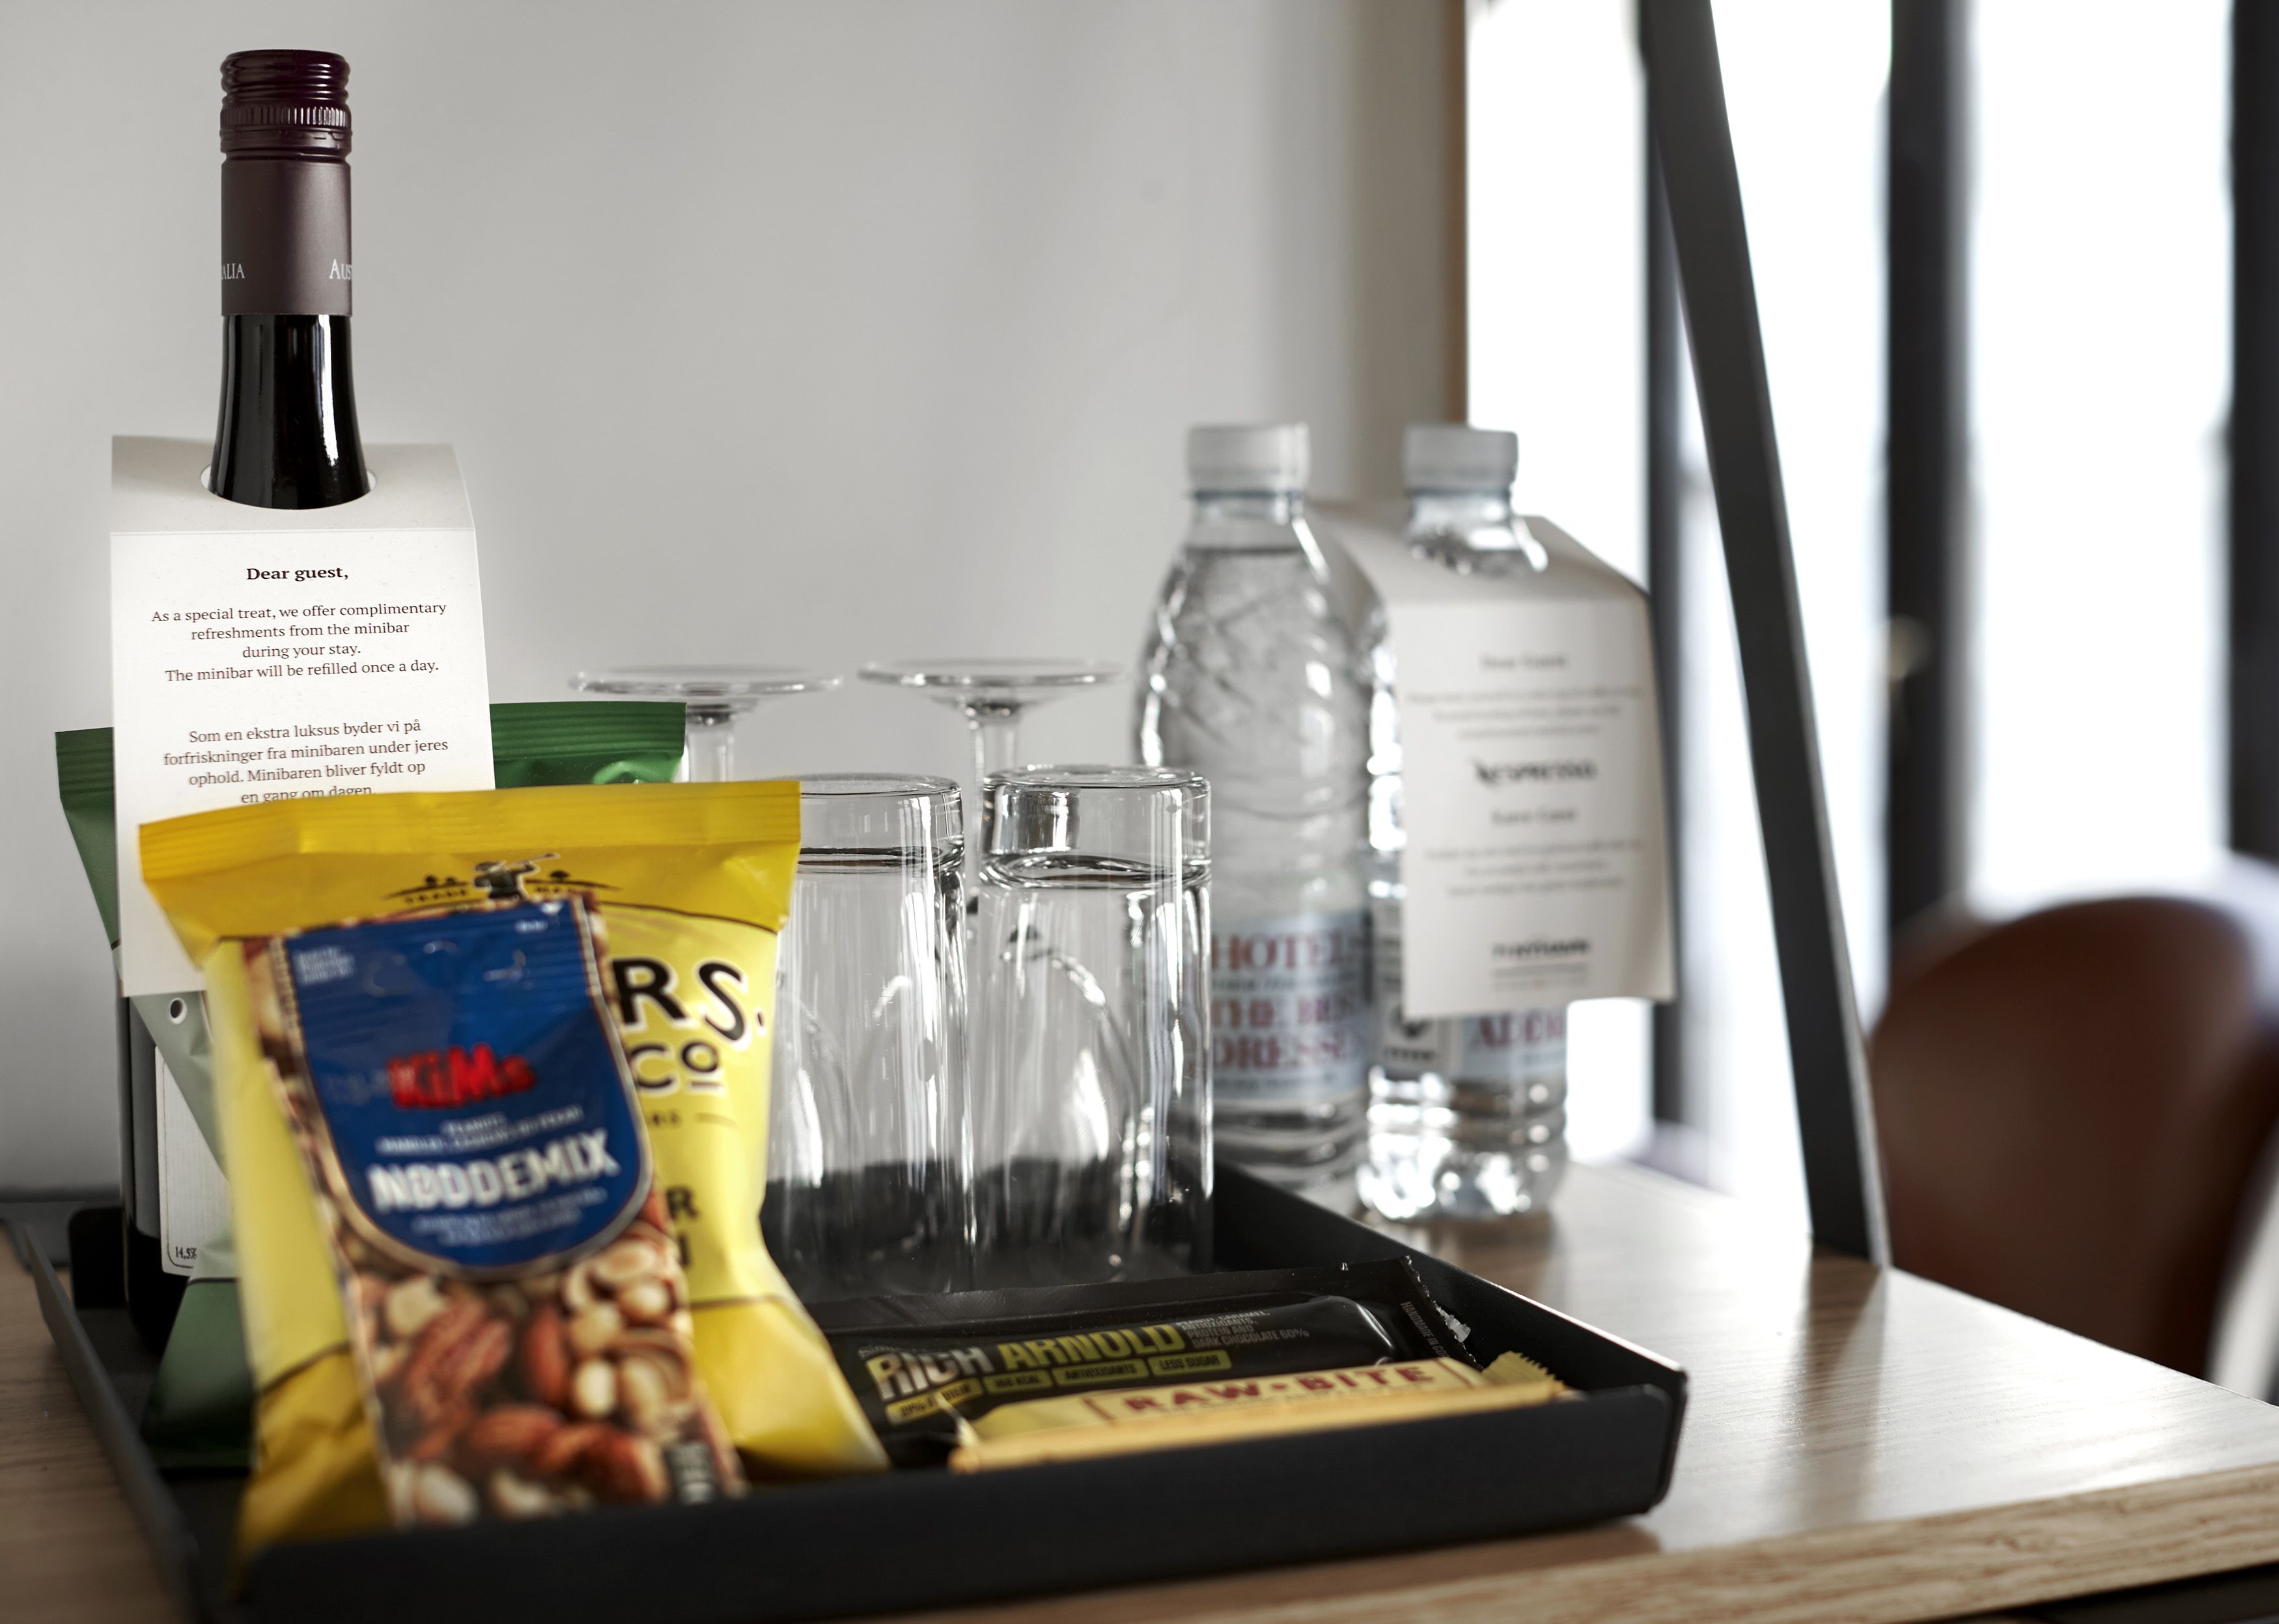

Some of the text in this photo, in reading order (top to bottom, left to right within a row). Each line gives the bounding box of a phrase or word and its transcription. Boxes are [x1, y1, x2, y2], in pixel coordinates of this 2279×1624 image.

[246, 567, 349, 582] Dear guest,
[151, 602, 447, 623] As a special treat, we offer complimentary
[191, 622, 410, 640] refreshments from the minibar
[242, 645, 361, 660] during your stay.
[165, 659, 439, 682] The minibar will be refilled once a day.
[189, 718, 421, 743] Som en ekstra luksus byder vi på
[163, 740, 449, 766] forfriskninger fra minibaren under jeres
[189, 761, 426, 788] ophold. Minibaren bliver fyldt op
[242, 793, 259, 804] en
[302, 789, 324, 798] om
[367, 1128, 622, 1214] NØDDEMIX
[1186, 1324, 1255, 1338] PROTEIN AND
[1192, 1328, 1310, 1348] DARK CHOCOLATE 60%
[866, 1324, 1186, 1400] RICH ARNOLD
[1158, 1354, 1222, 1369] LESS SUGAR
